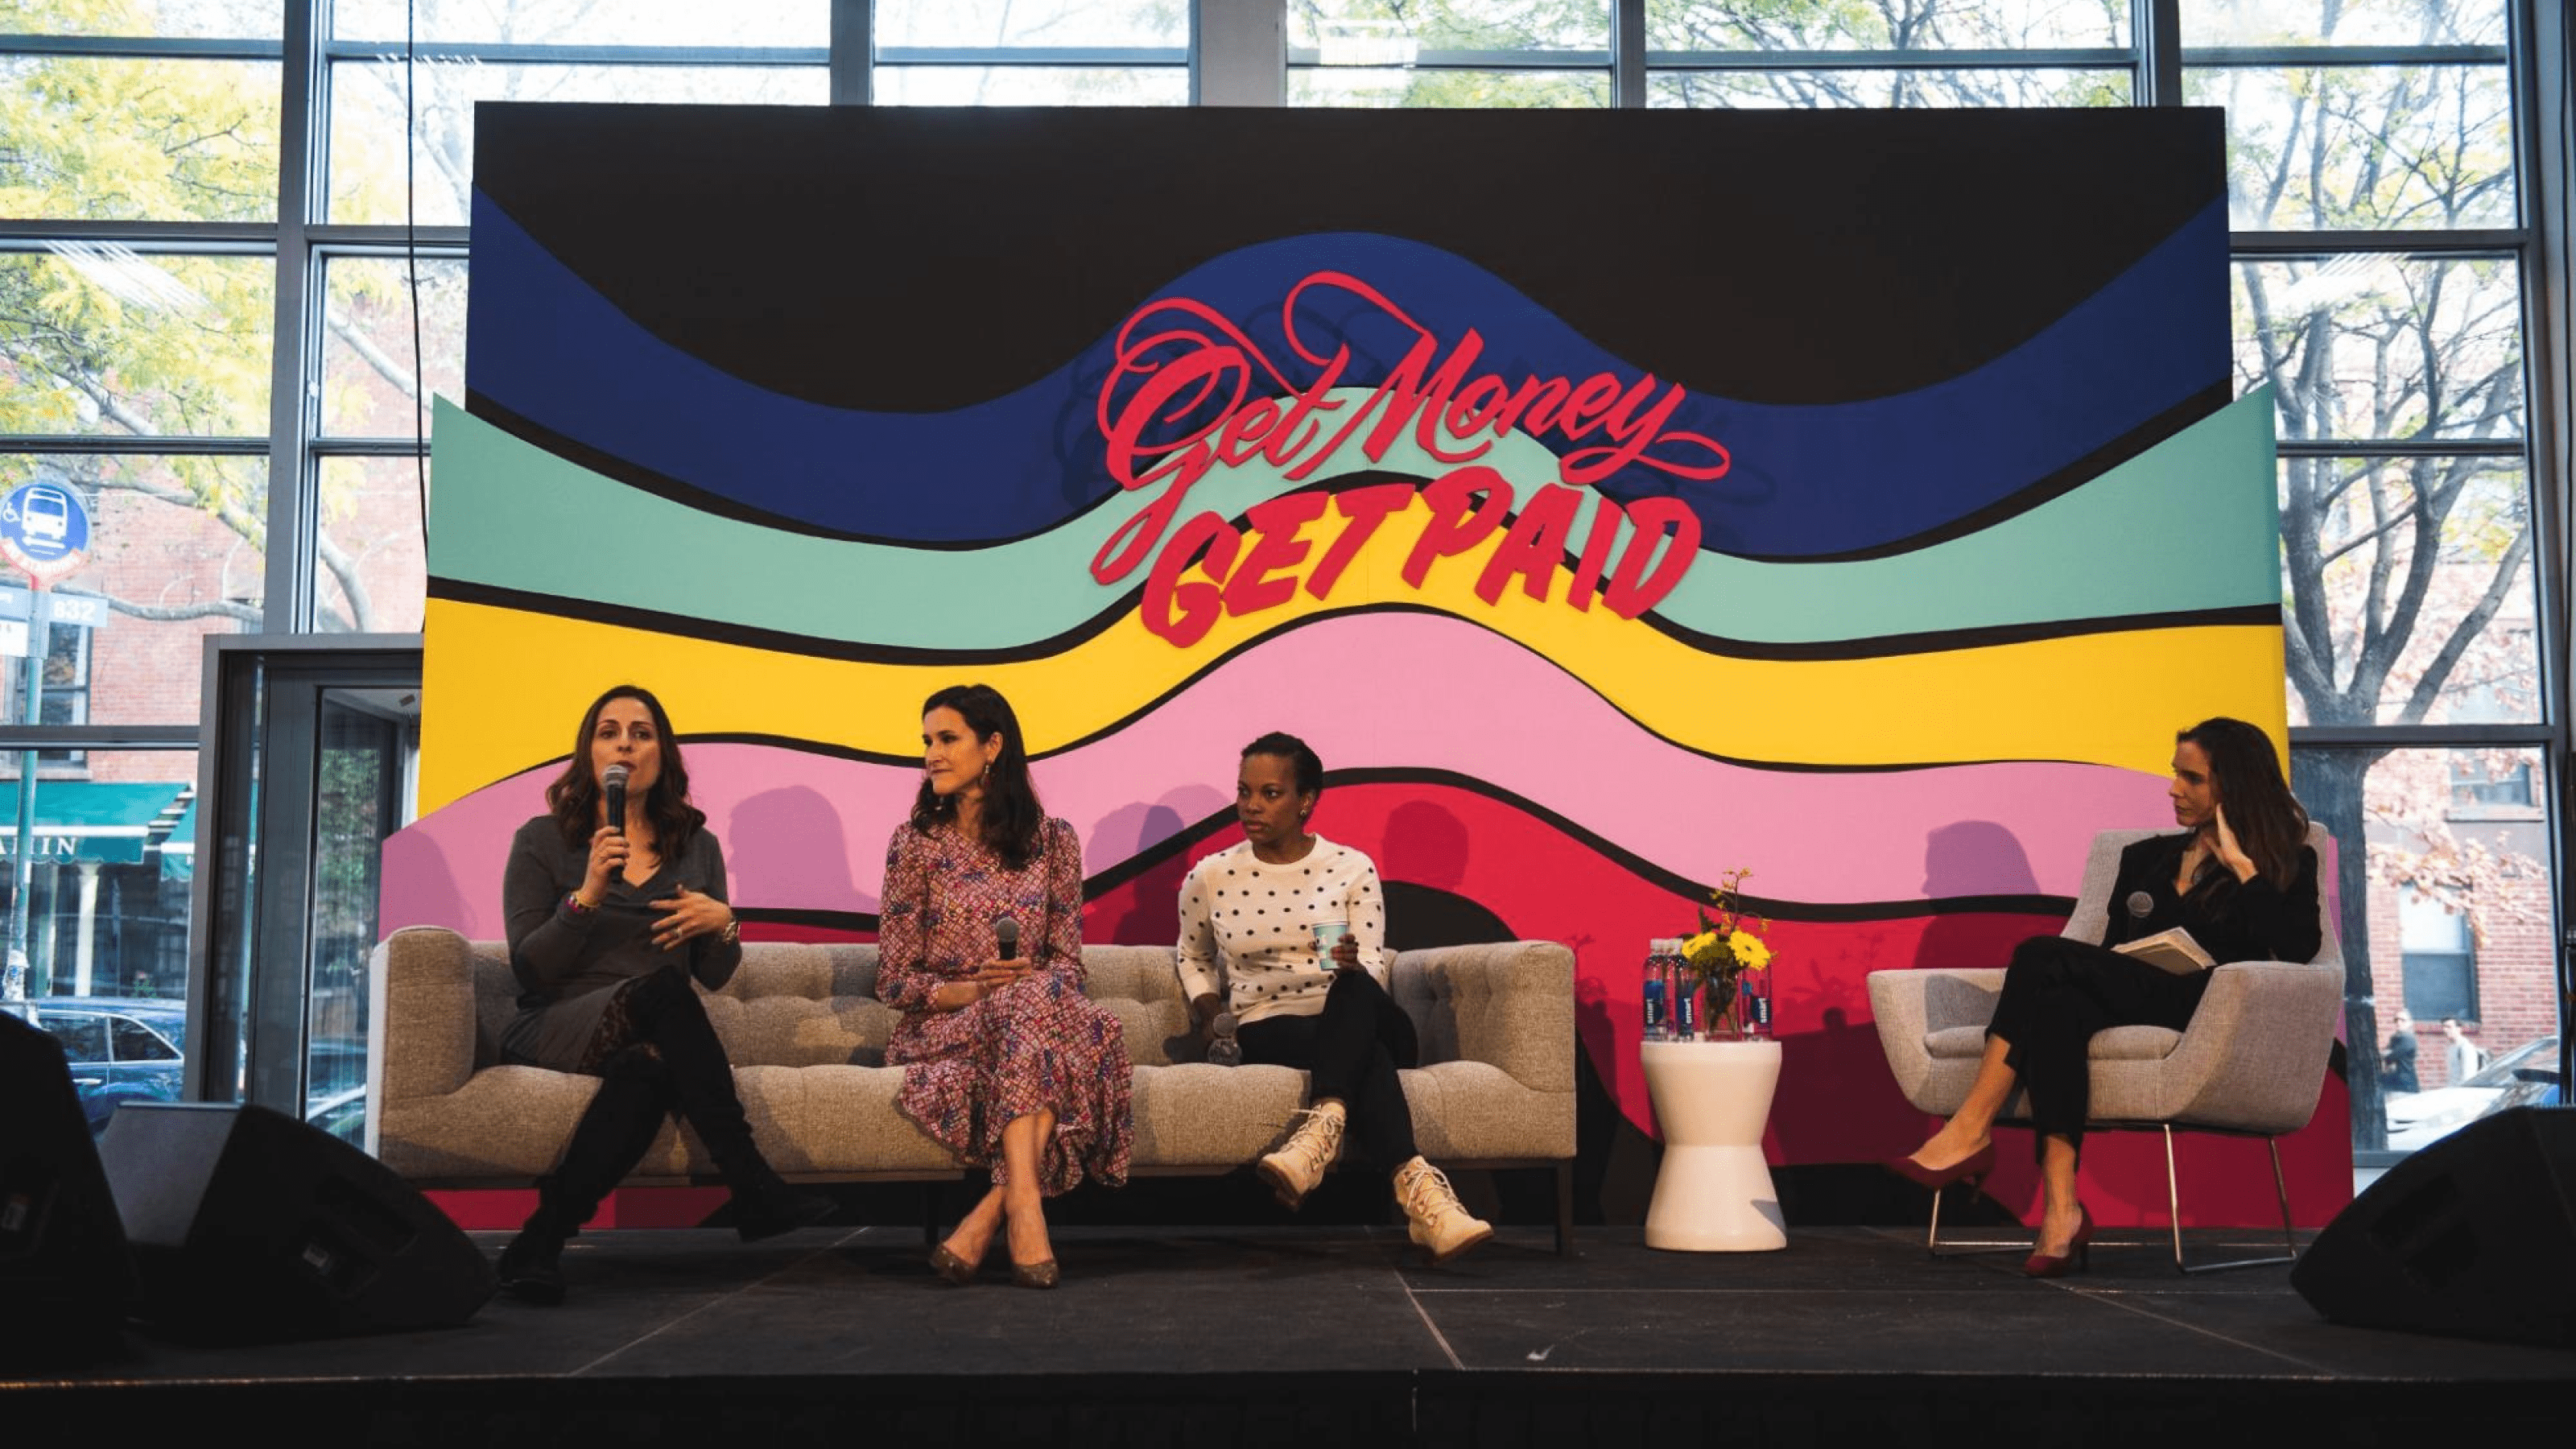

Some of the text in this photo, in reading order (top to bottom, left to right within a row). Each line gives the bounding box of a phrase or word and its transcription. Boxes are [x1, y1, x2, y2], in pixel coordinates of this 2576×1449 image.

[1090, 271, 1731, 586] Get Money
[1141, 466, 1702, 649] GET PAID
